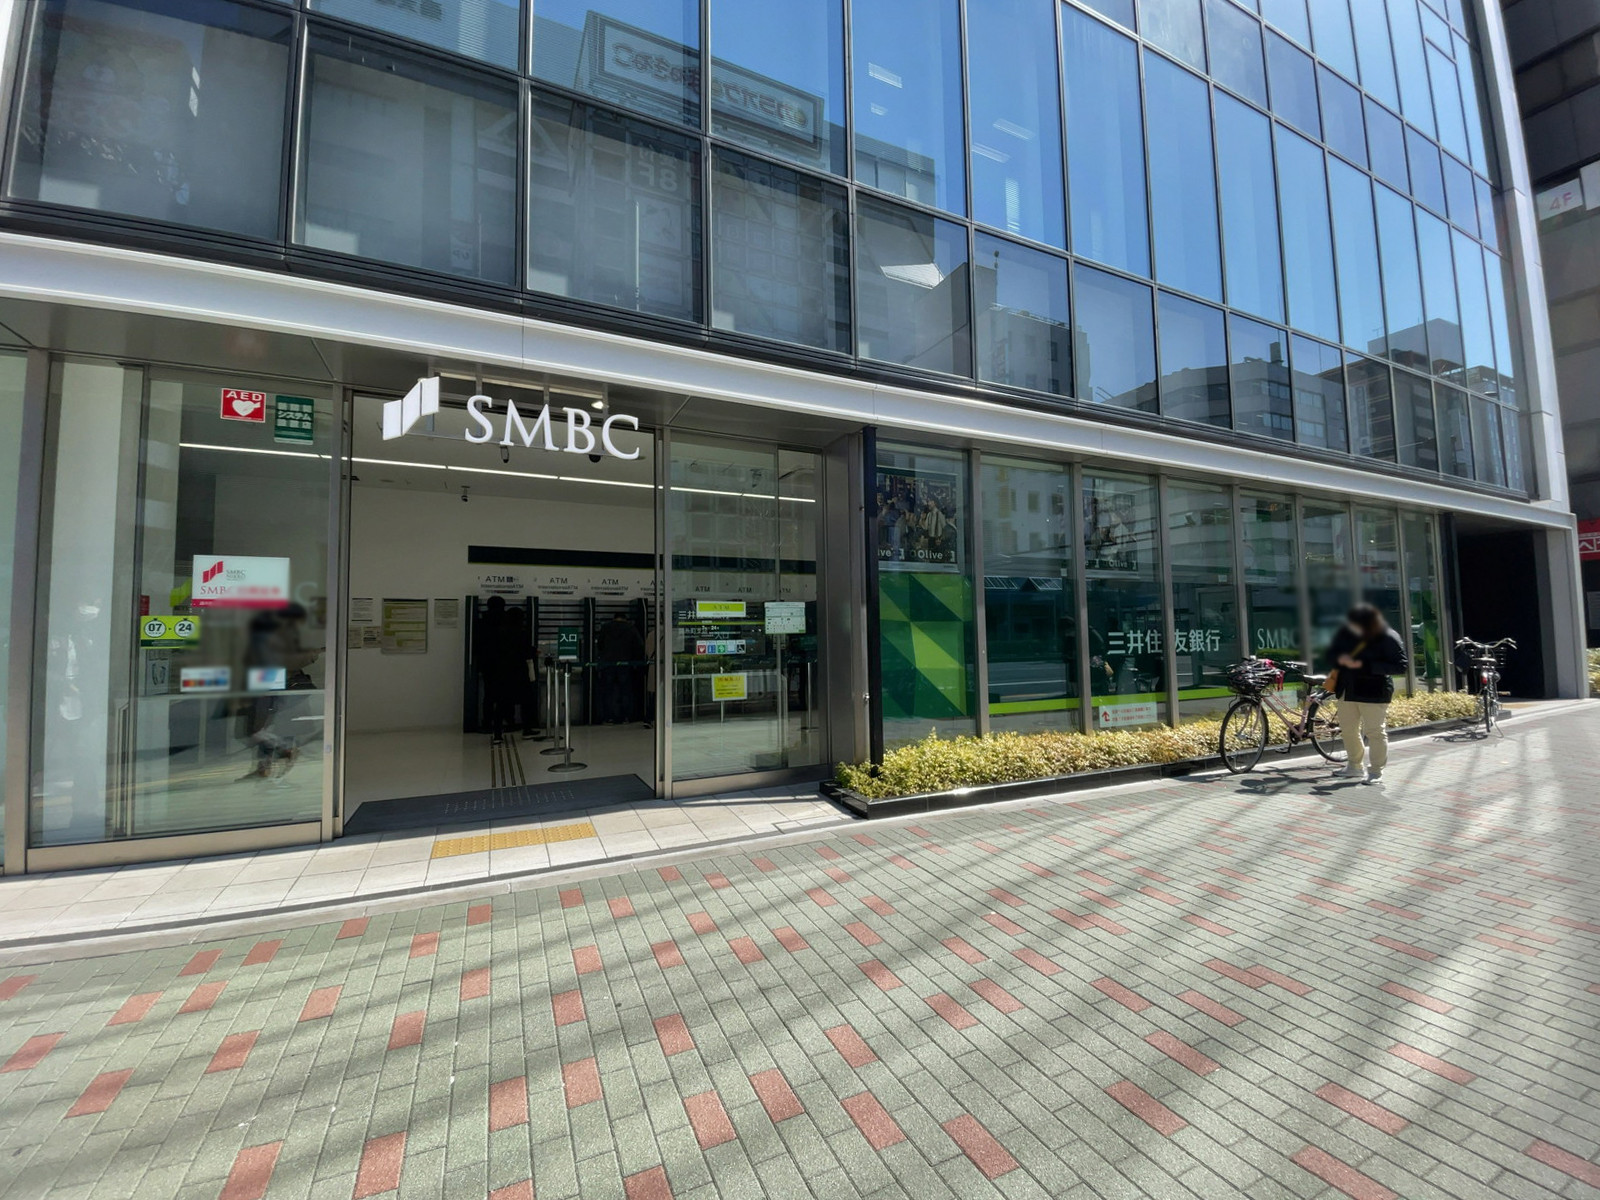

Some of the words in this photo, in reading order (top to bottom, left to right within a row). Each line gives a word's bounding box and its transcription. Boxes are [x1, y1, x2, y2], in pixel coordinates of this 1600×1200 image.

[225, 390, 263, 402] AED
[465, 394, 641, 460] SMBC
[917, 549, 943, 560] Olive
[485, 575, 505, 583] ATM
[148, 623, 162, 632] 07
[178, 623, 192, 632] 24
[559, 633, 577, 642] 入口
[1107, 629, 1221, 655] 三井住友銀行
